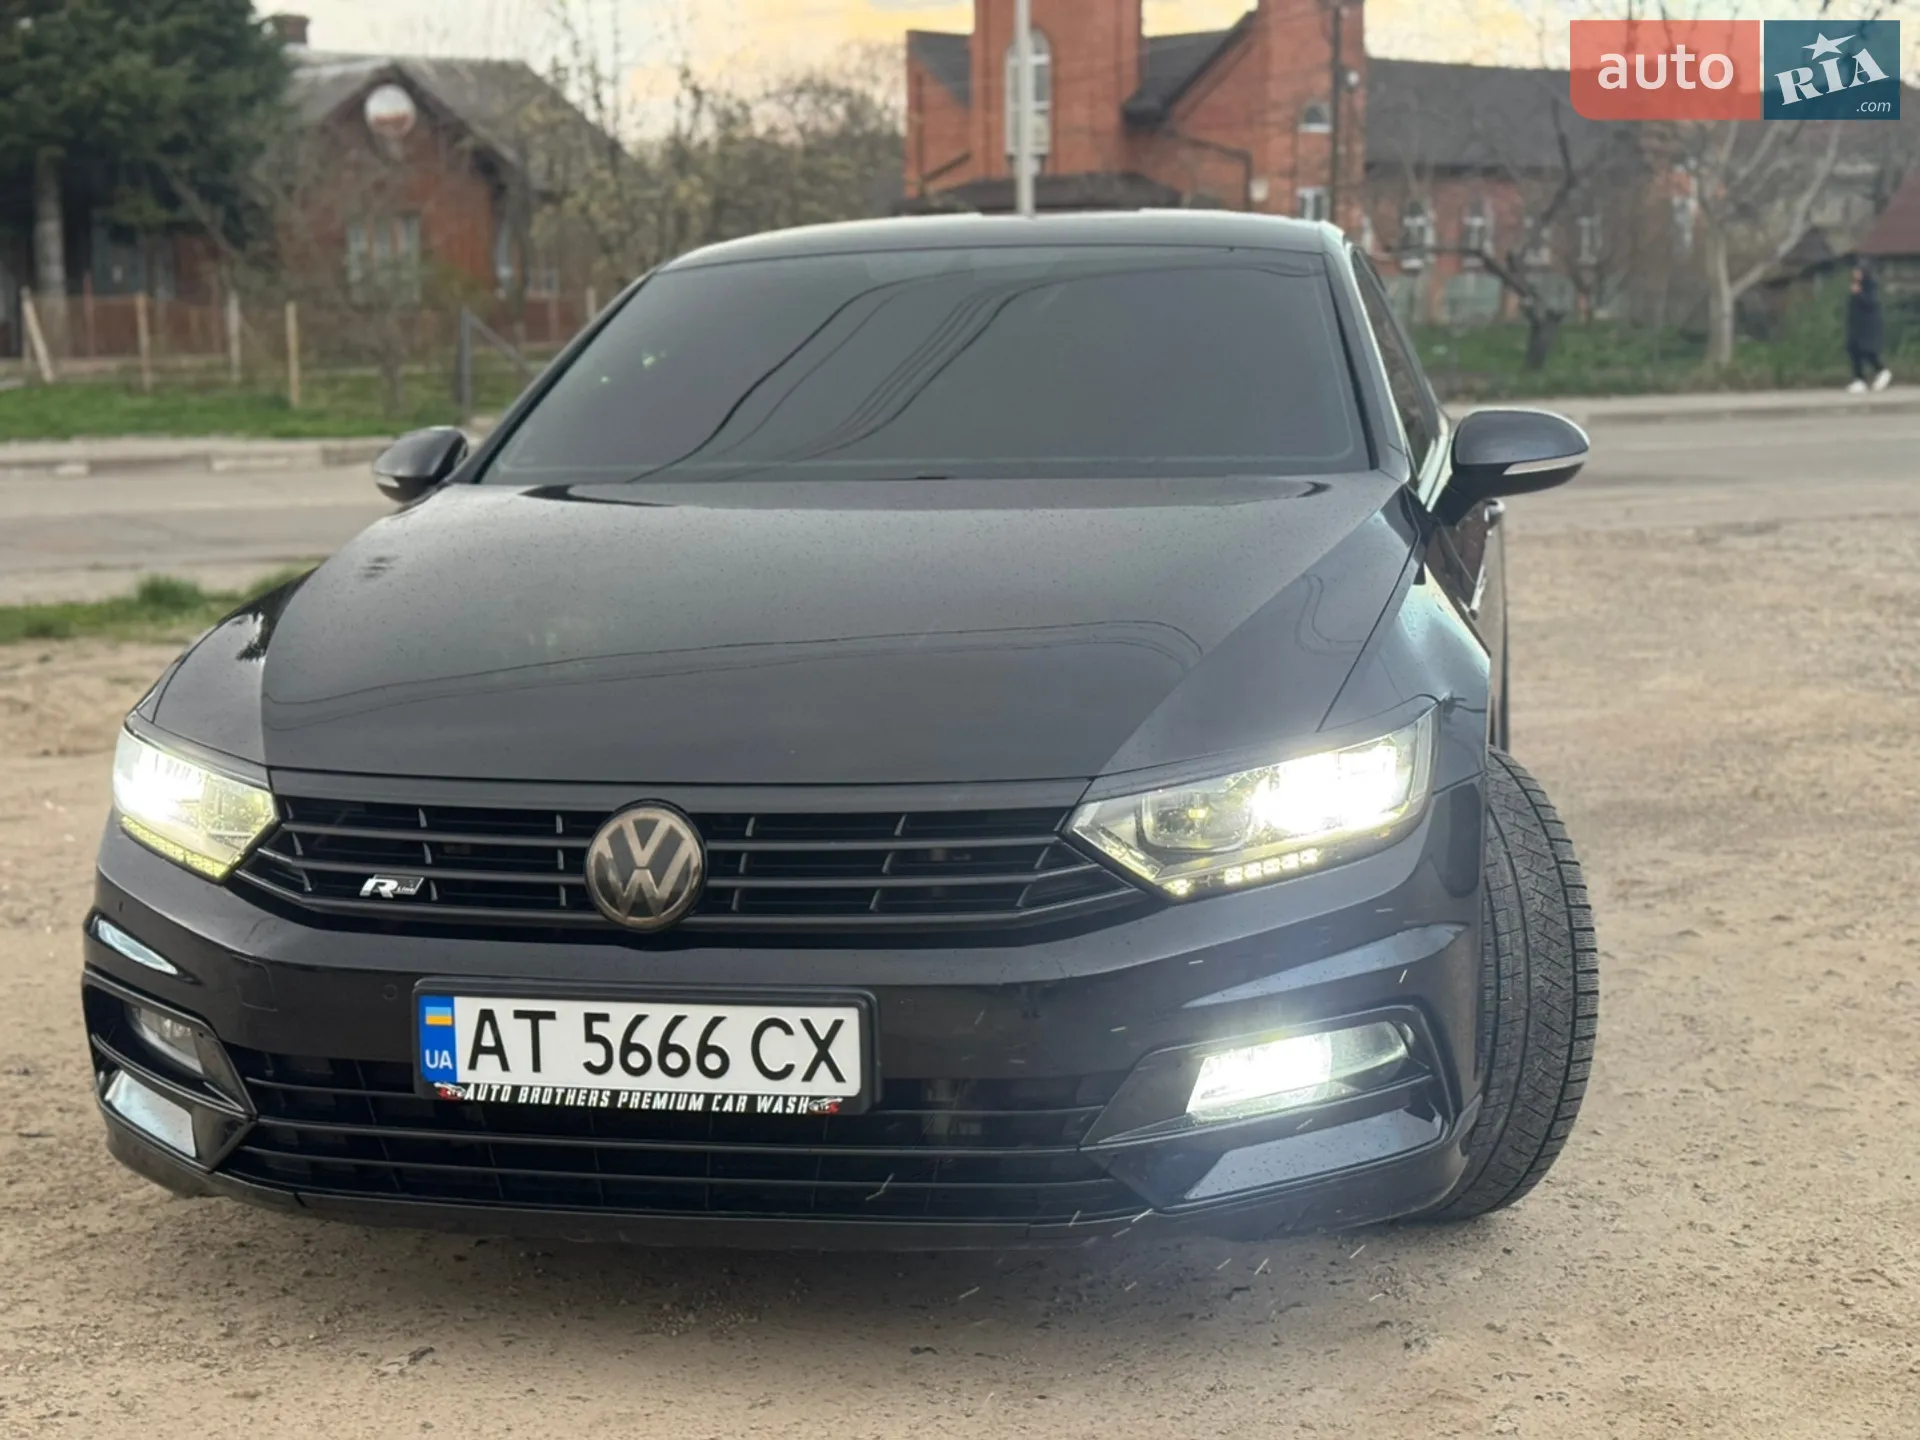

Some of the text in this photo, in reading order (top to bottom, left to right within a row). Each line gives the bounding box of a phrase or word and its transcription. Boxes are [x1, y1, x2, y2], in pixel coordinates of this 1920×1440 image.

[425, 1049, 453, 1070] UA
[467, 1008, 847, 1084] AT 5666 CX
[464, 1083, 810, 1115] AUTO BROTHERS PREMIUM CAR WASH
